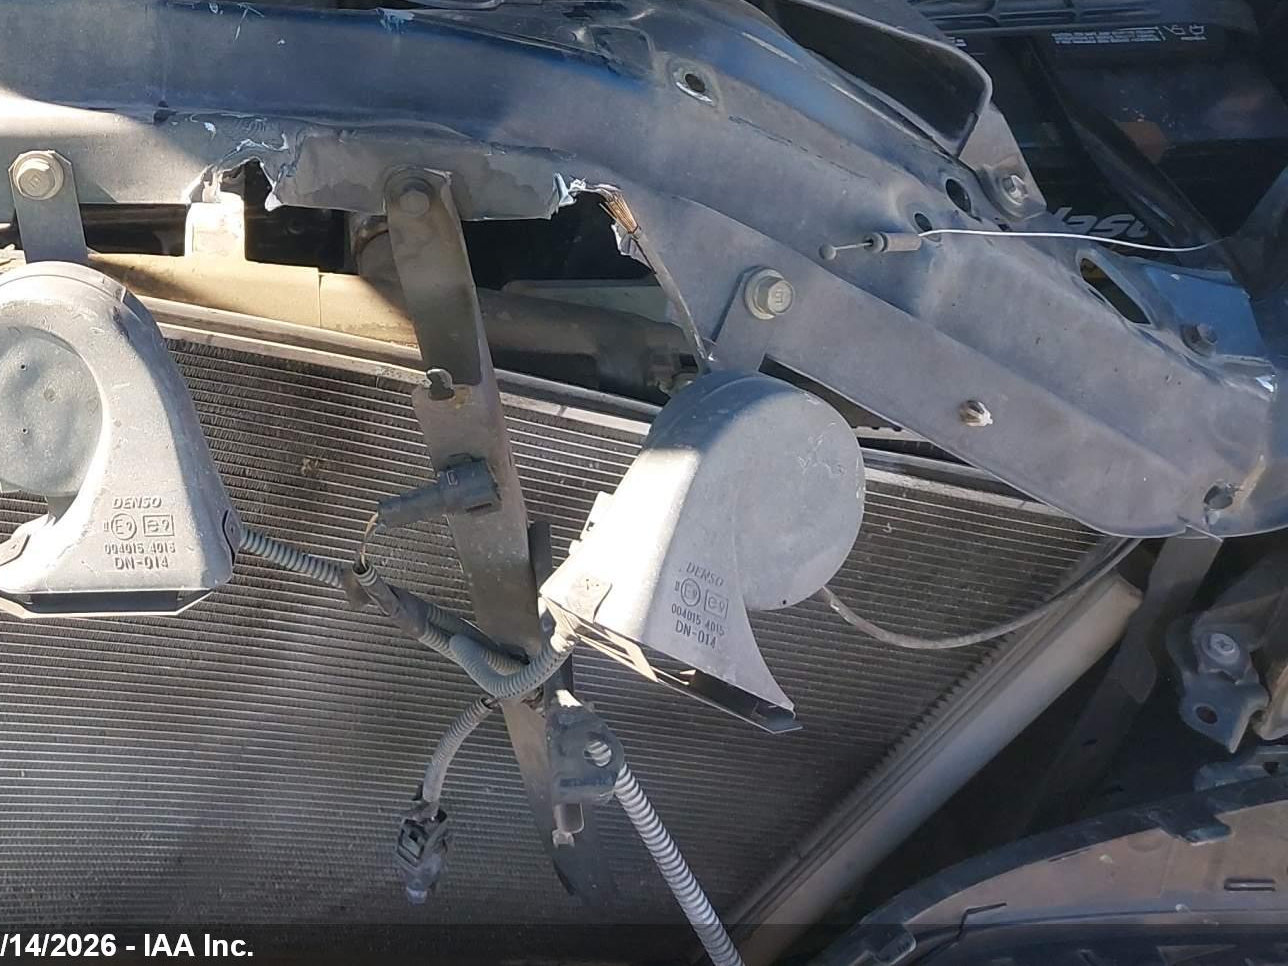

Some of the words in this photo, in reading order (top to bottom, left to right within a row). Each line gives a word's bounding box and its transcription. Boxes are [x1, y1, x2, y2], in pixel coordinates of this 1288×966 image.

[112, 497, 162, 510] DENSO
[114, 555, 170, 570] DN-014
[686, 561, 725, 587] DENSO
[675, 620, 716, 649] DN-014
